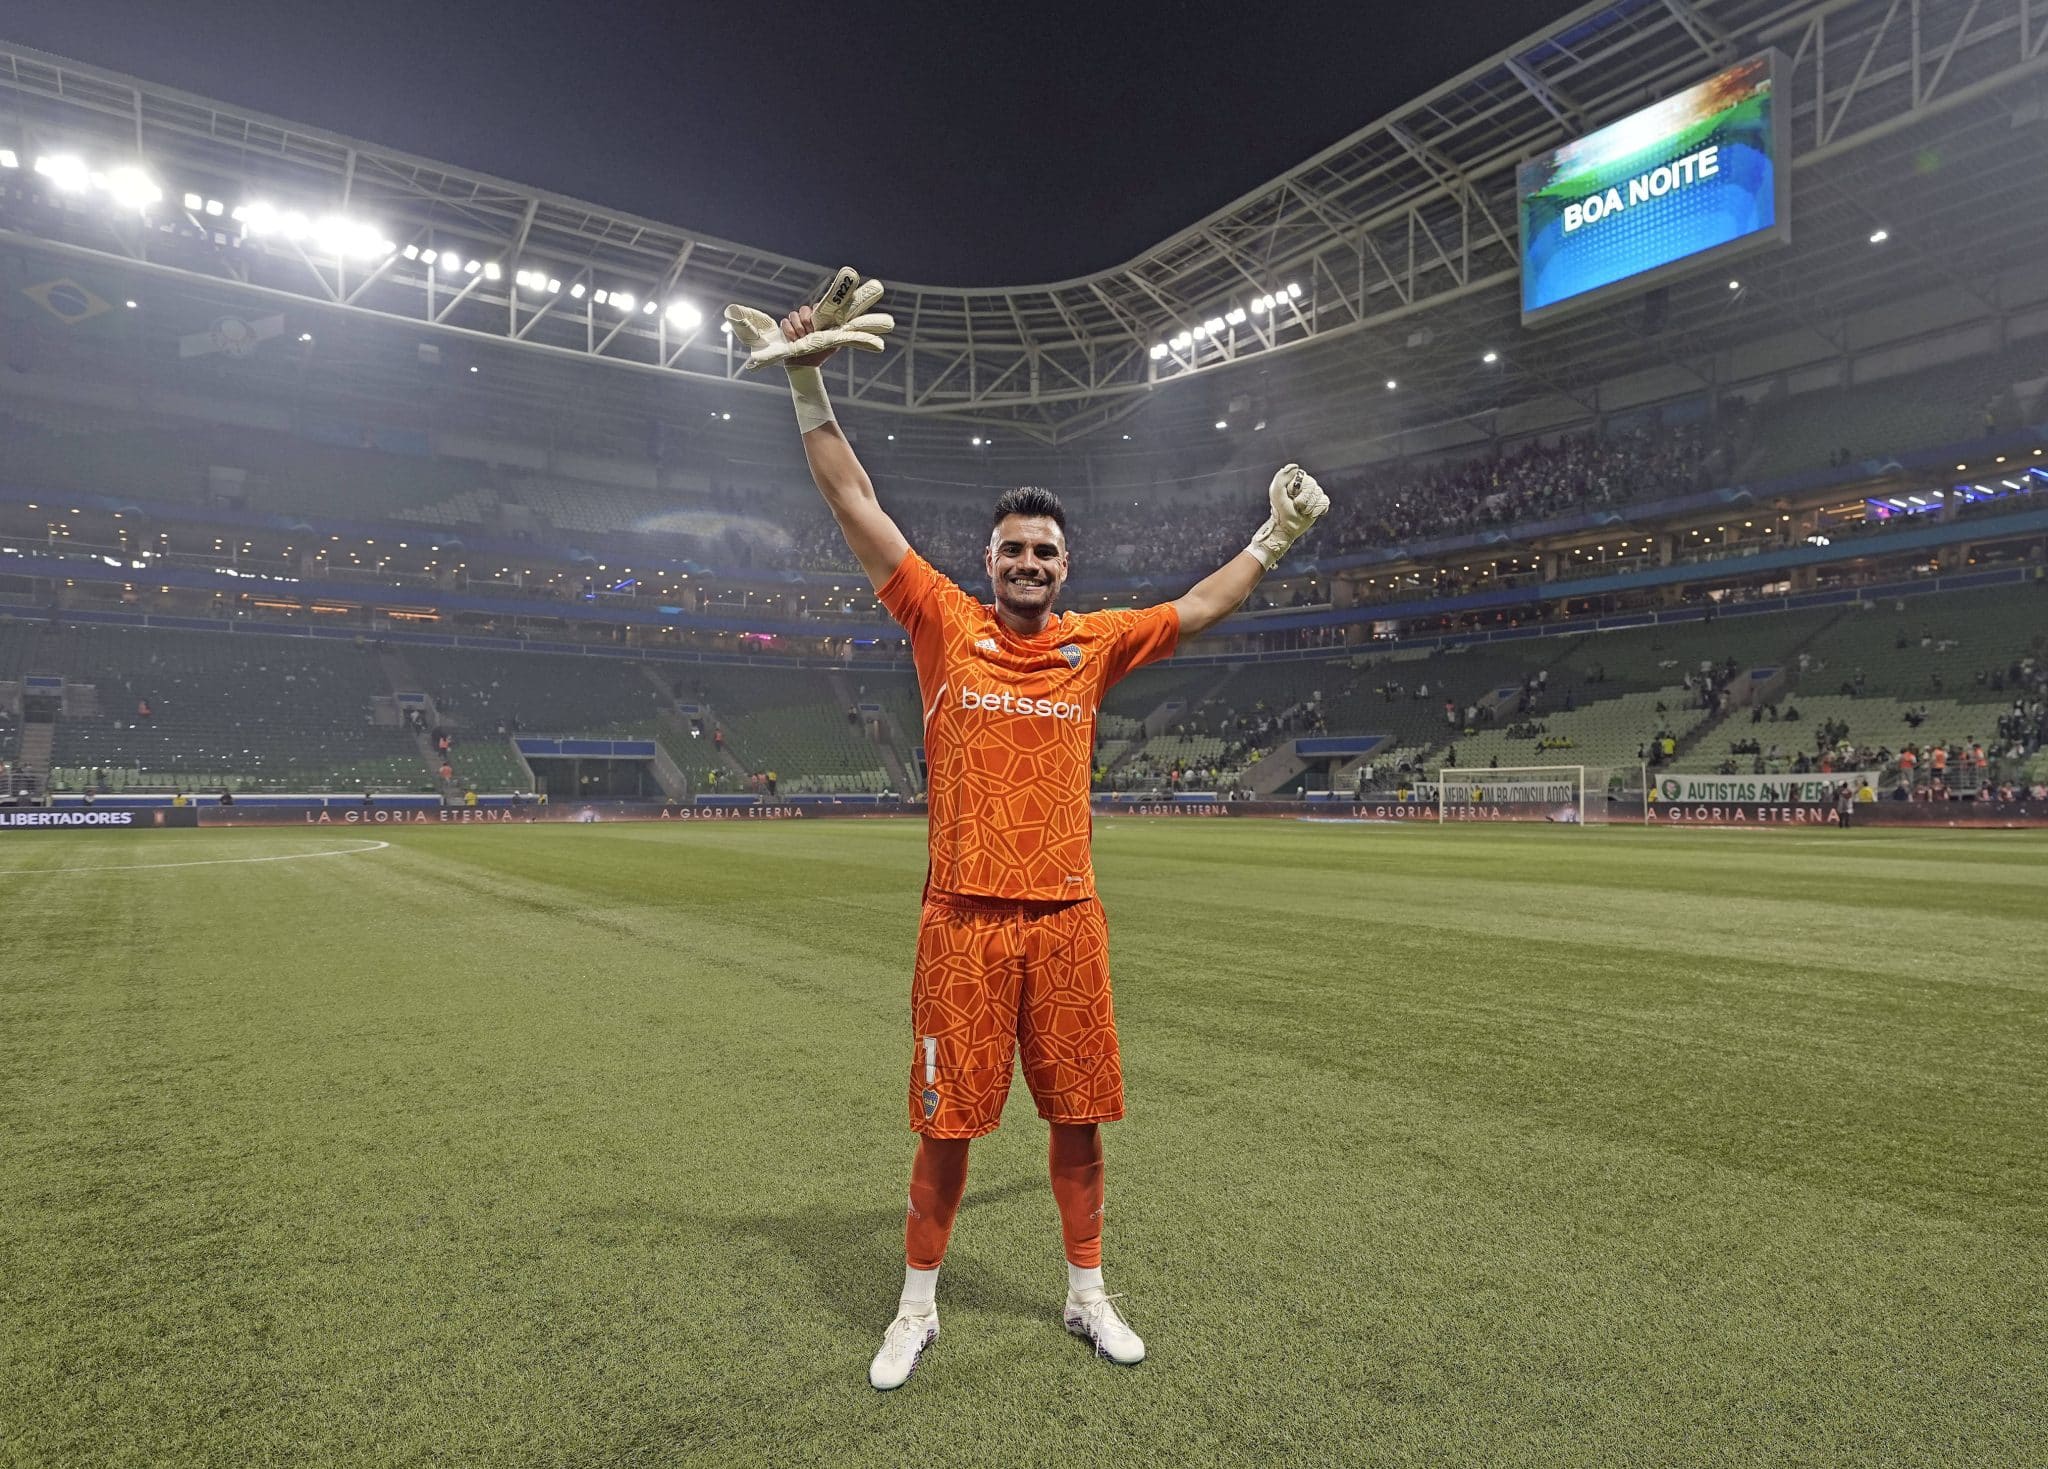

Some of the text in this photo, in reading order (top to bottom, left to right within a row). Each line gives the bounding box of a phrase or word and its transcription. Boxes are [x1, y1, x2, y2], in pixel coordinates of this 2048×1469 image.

[1563, 145, 1720, 233] BOA NOITE
[832, 275, 854, 305] SR22
[962, 685, 1082, 722] betsson
[1688, 782, 1756, 801] AUTISTAS
[306, 808, 513, 823] LA GLORIA ETERNA
[661, 808, 670, 819] A
[749, 807, 803, 818] ETERNA
[1128, 805, 1135, 815] A
[1186, 804, 1229, 815] ETERNA
[1353, 806, 1368, 816] LA
[1442, 806, 1500, 818] ETERNA
[1669, 804, 1746, 821] GLÓRIA
[1758, 807, 1840, 822] ETERNA
[0, 812, 132, 826] LIBERTADORES
